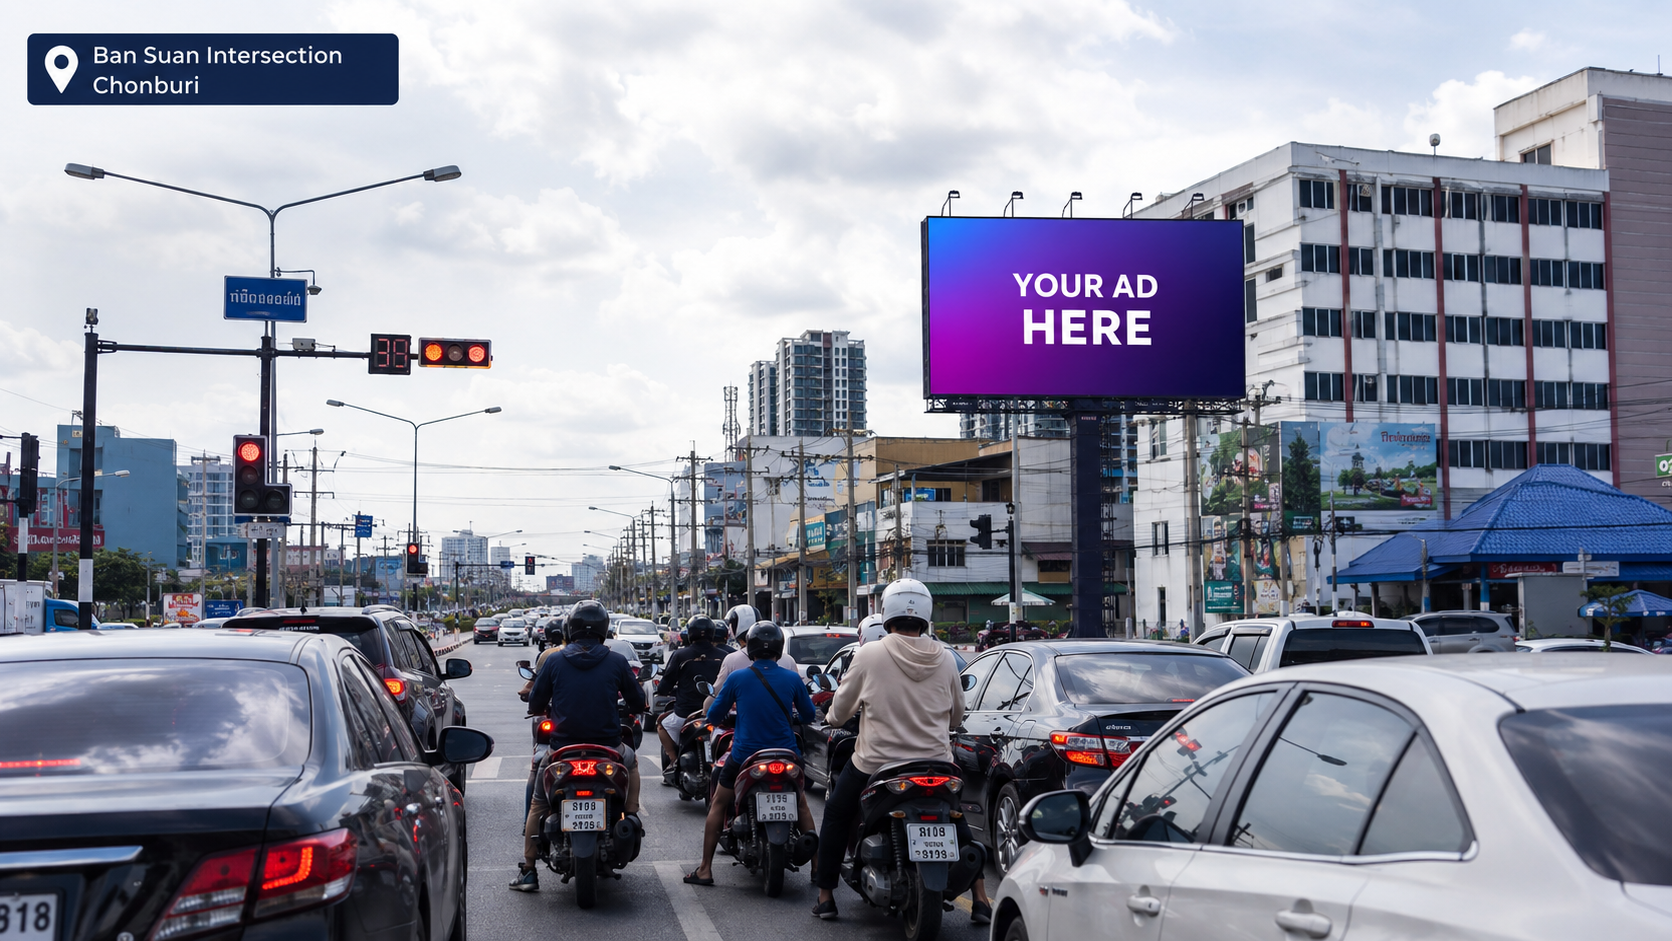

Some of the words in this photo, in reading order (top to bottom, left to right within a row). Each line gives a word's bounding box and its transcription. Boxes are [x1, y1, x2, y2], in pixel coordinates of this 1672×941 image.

[1012, 273, 1104, 298] YOUR
[1112, 274, 1158, 298] AD
[1023, 309, 1152, 346] HERE
